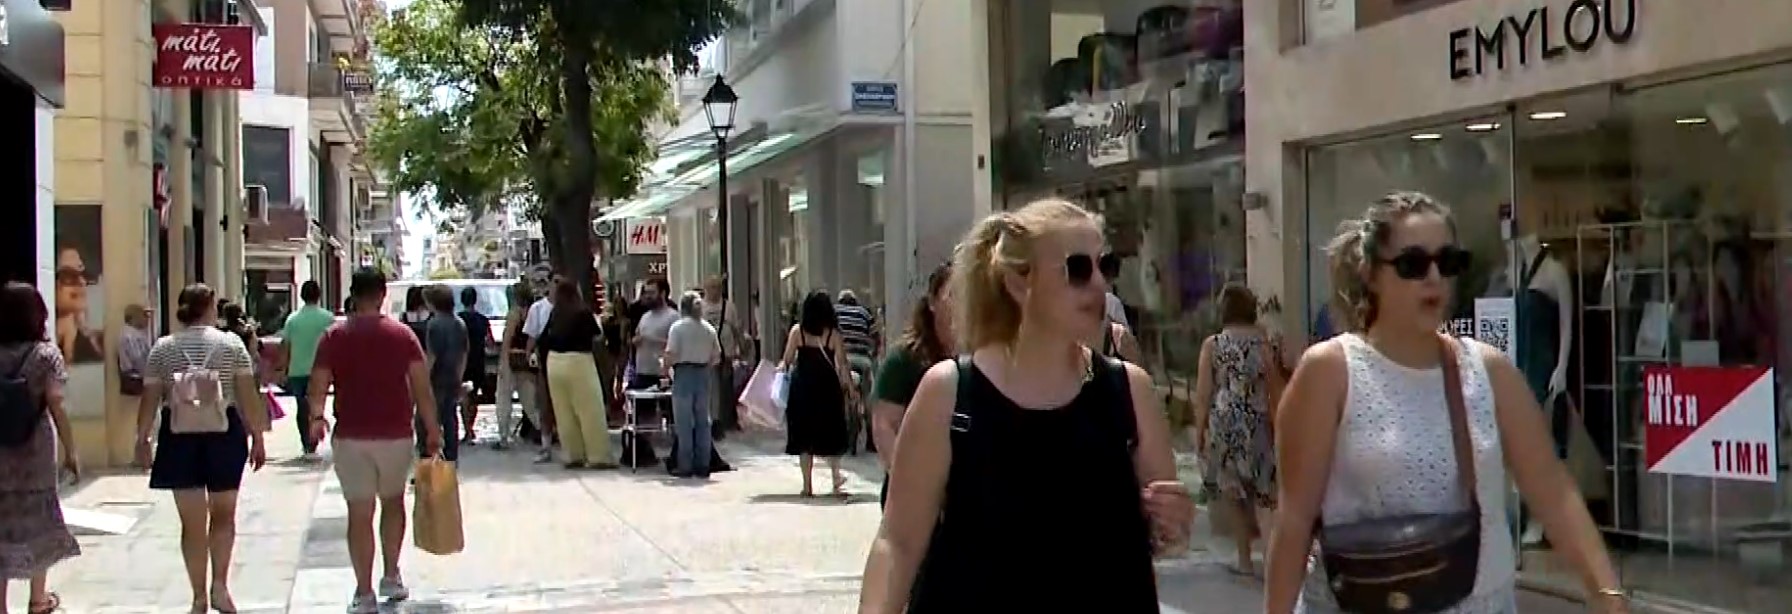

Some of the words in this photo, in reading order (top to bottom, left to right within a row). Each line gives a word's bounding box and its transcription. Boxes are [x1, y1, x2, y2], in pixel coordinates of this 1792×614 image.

[1449, 0, 1637, 80] EMYLOU
[1647, 373, 1673, 396] ΟΛΑ
[1648, 394, 1698, 427] ΜΙΣΗ
[1711, 439, 1769, 476] ΤΙΜΗ
